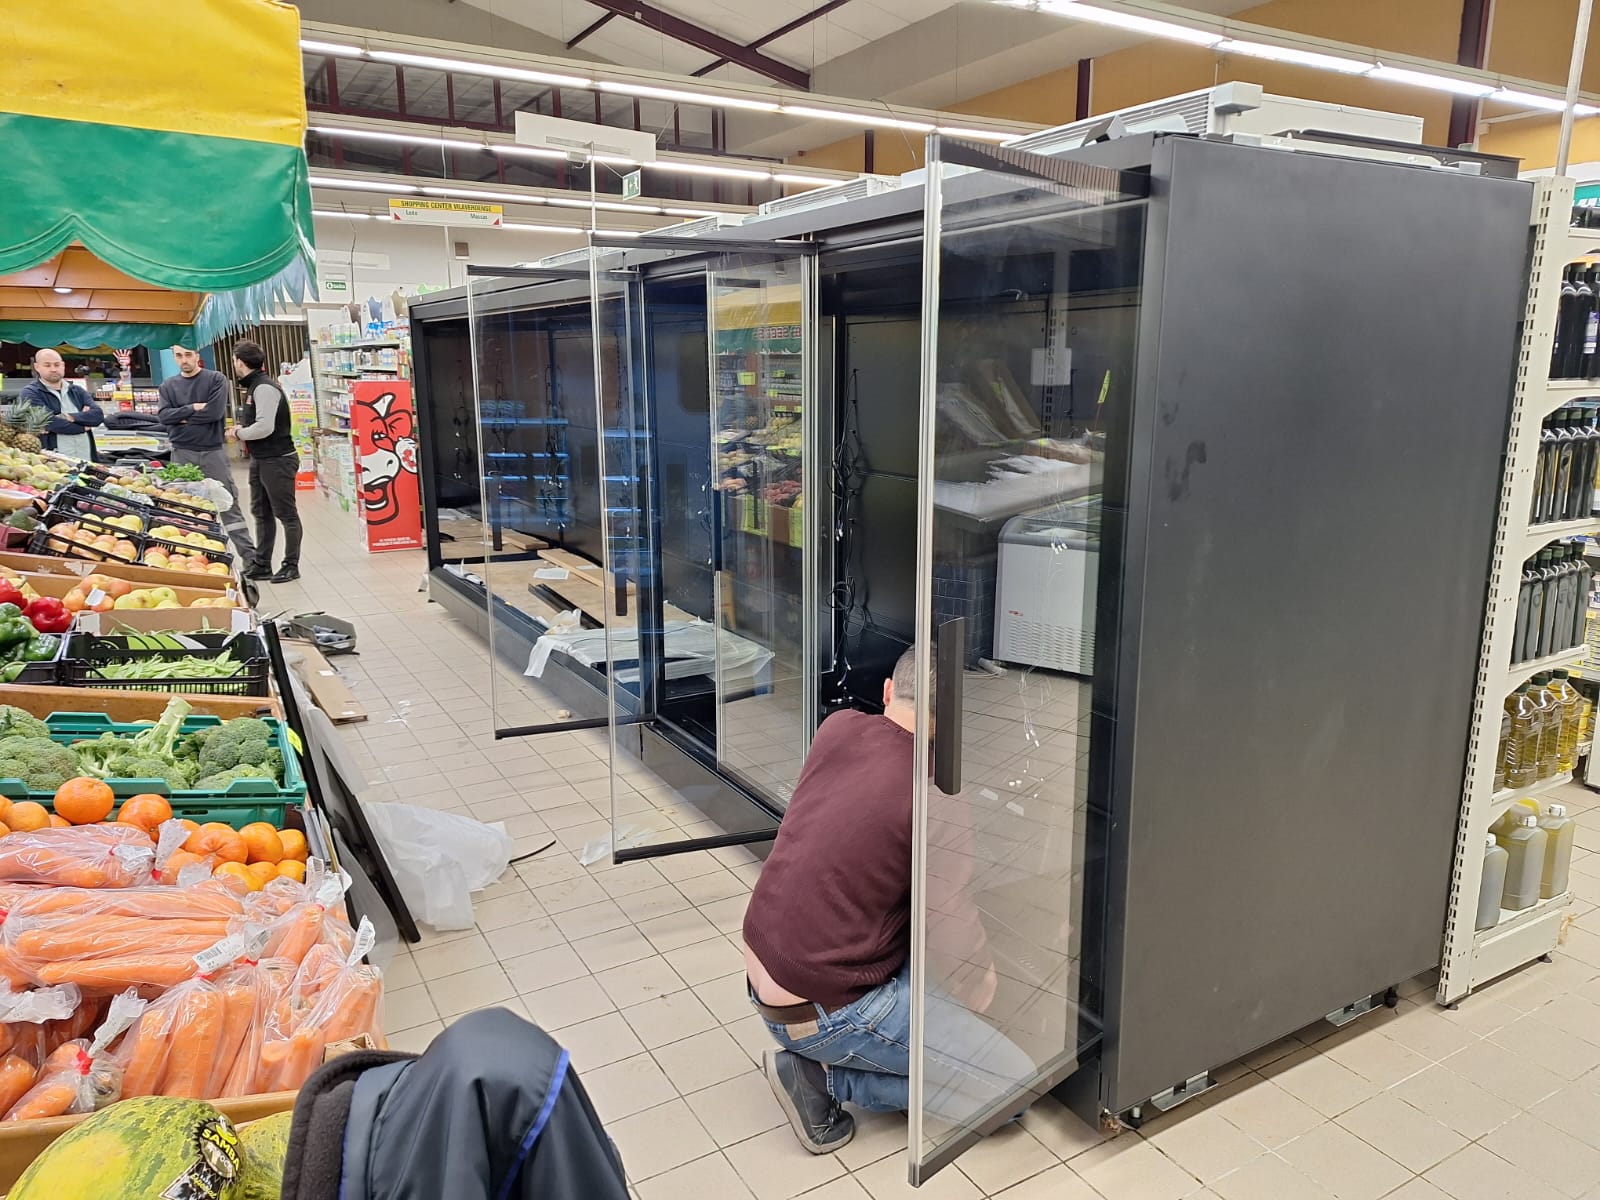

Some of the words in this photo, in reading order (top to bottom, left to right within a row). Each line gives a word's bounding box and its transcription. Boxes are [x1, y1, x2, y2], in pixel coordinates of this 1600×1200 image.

[401, 200, 429, 208] SHOPPING
[431, 202, 452, 210] CENTER
[202, 1129, 239, 1171] SAMBA
